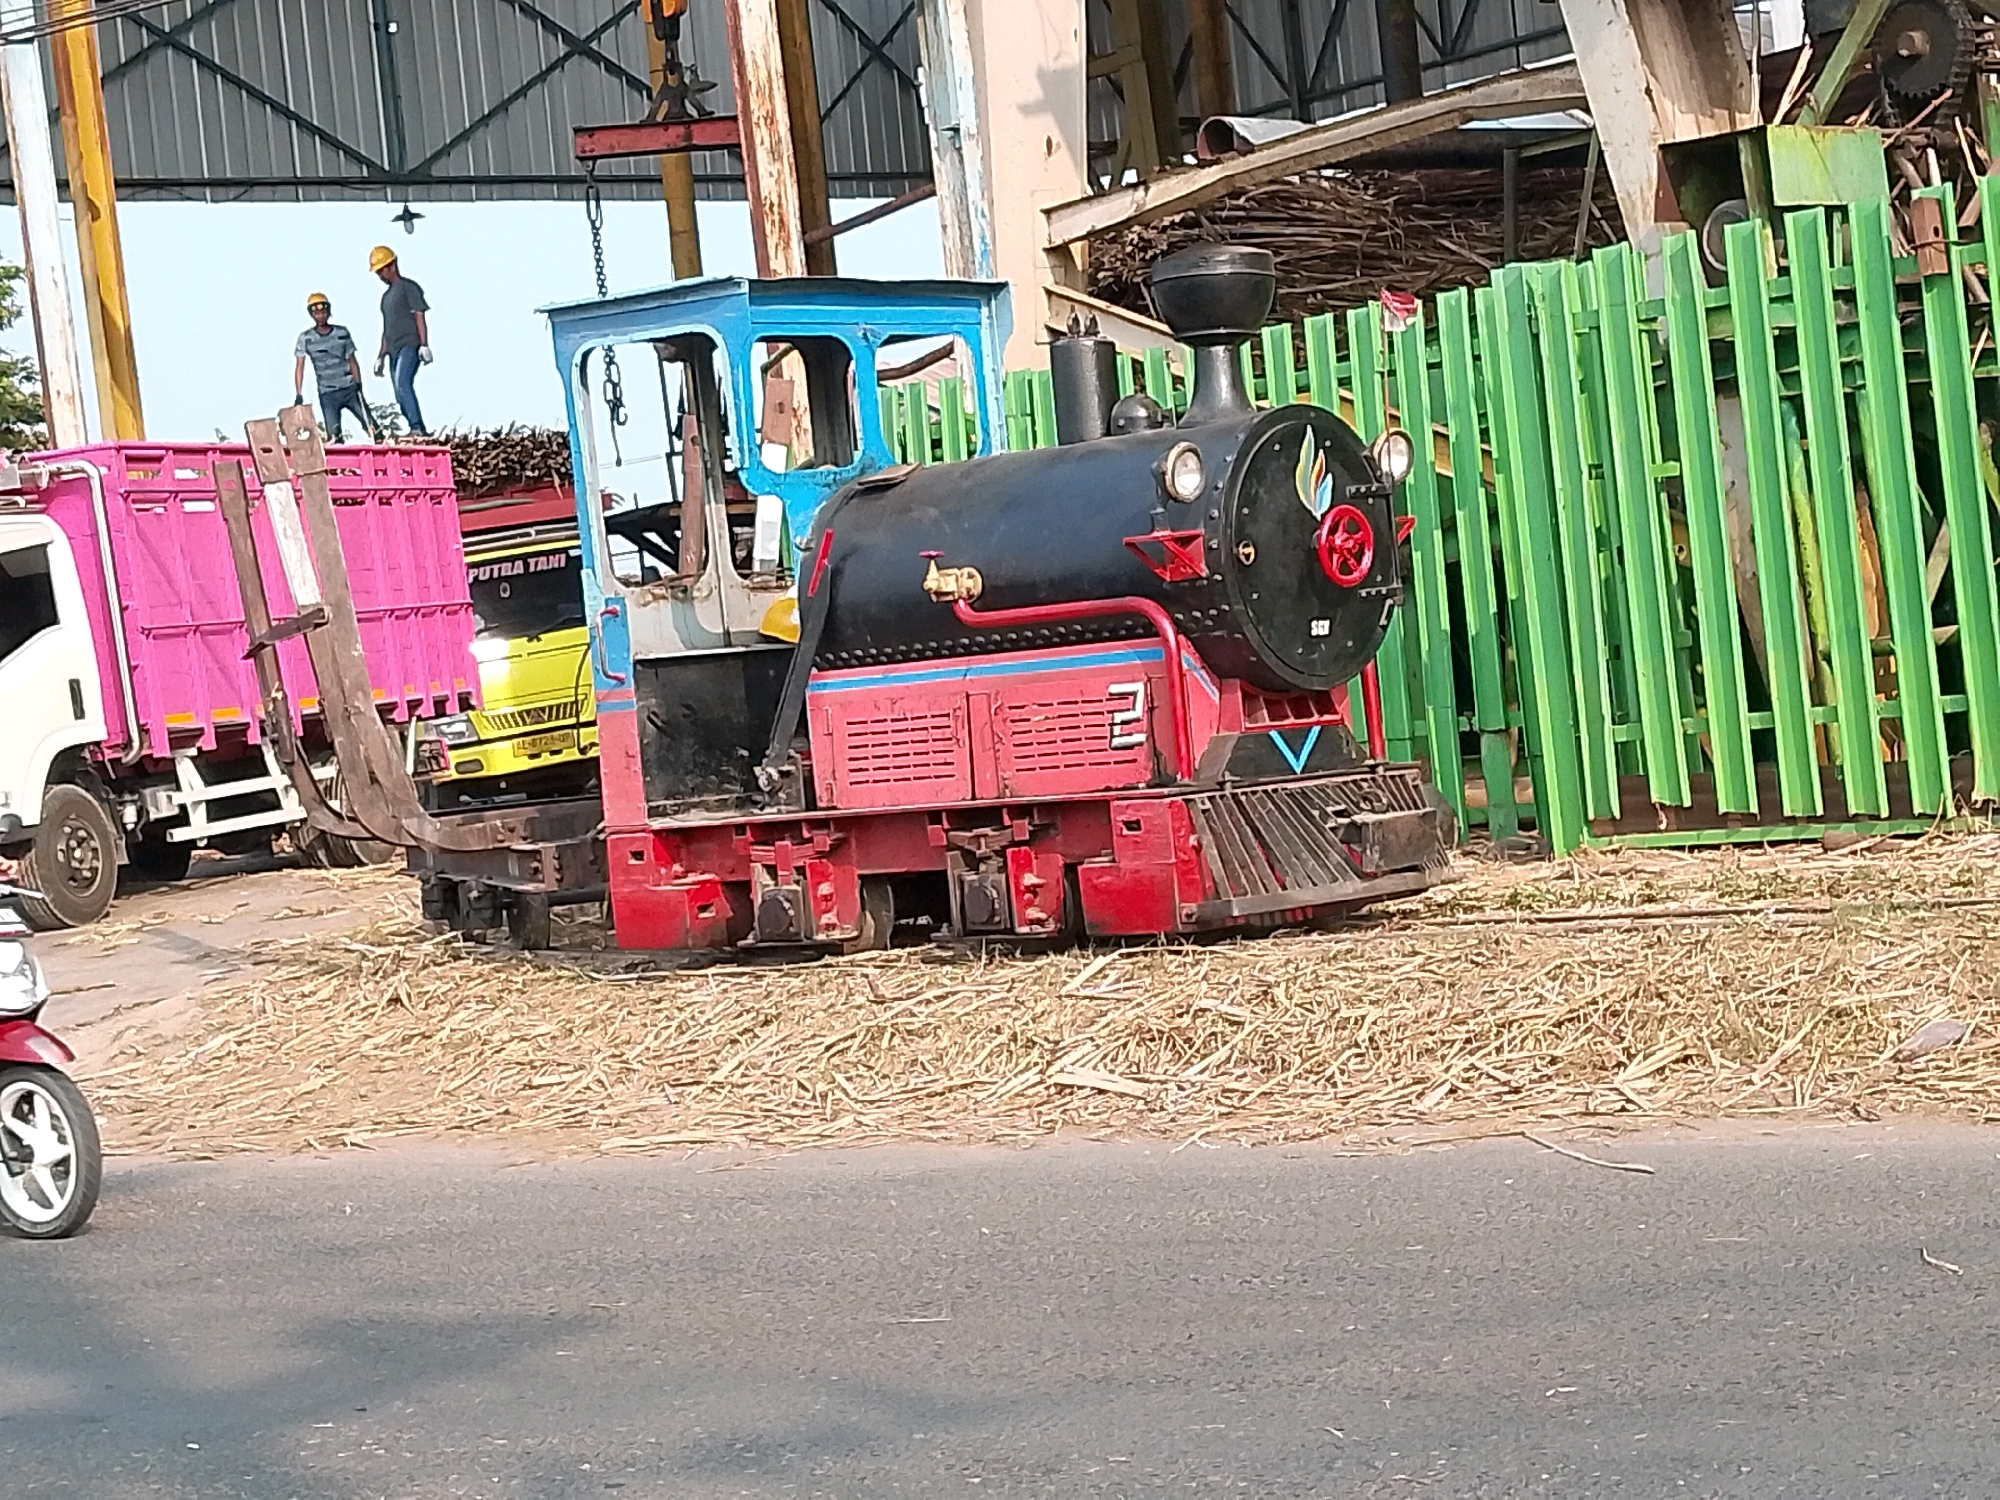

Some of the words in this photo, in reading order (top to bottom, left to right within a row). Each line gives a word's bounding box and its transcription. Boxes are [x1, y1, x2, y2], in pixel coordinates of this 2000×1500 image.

[468, 560, 525, 584] PUTRA
[527, 553, 566, 573] TANI
[1107, 681, 1148, 749] 2
